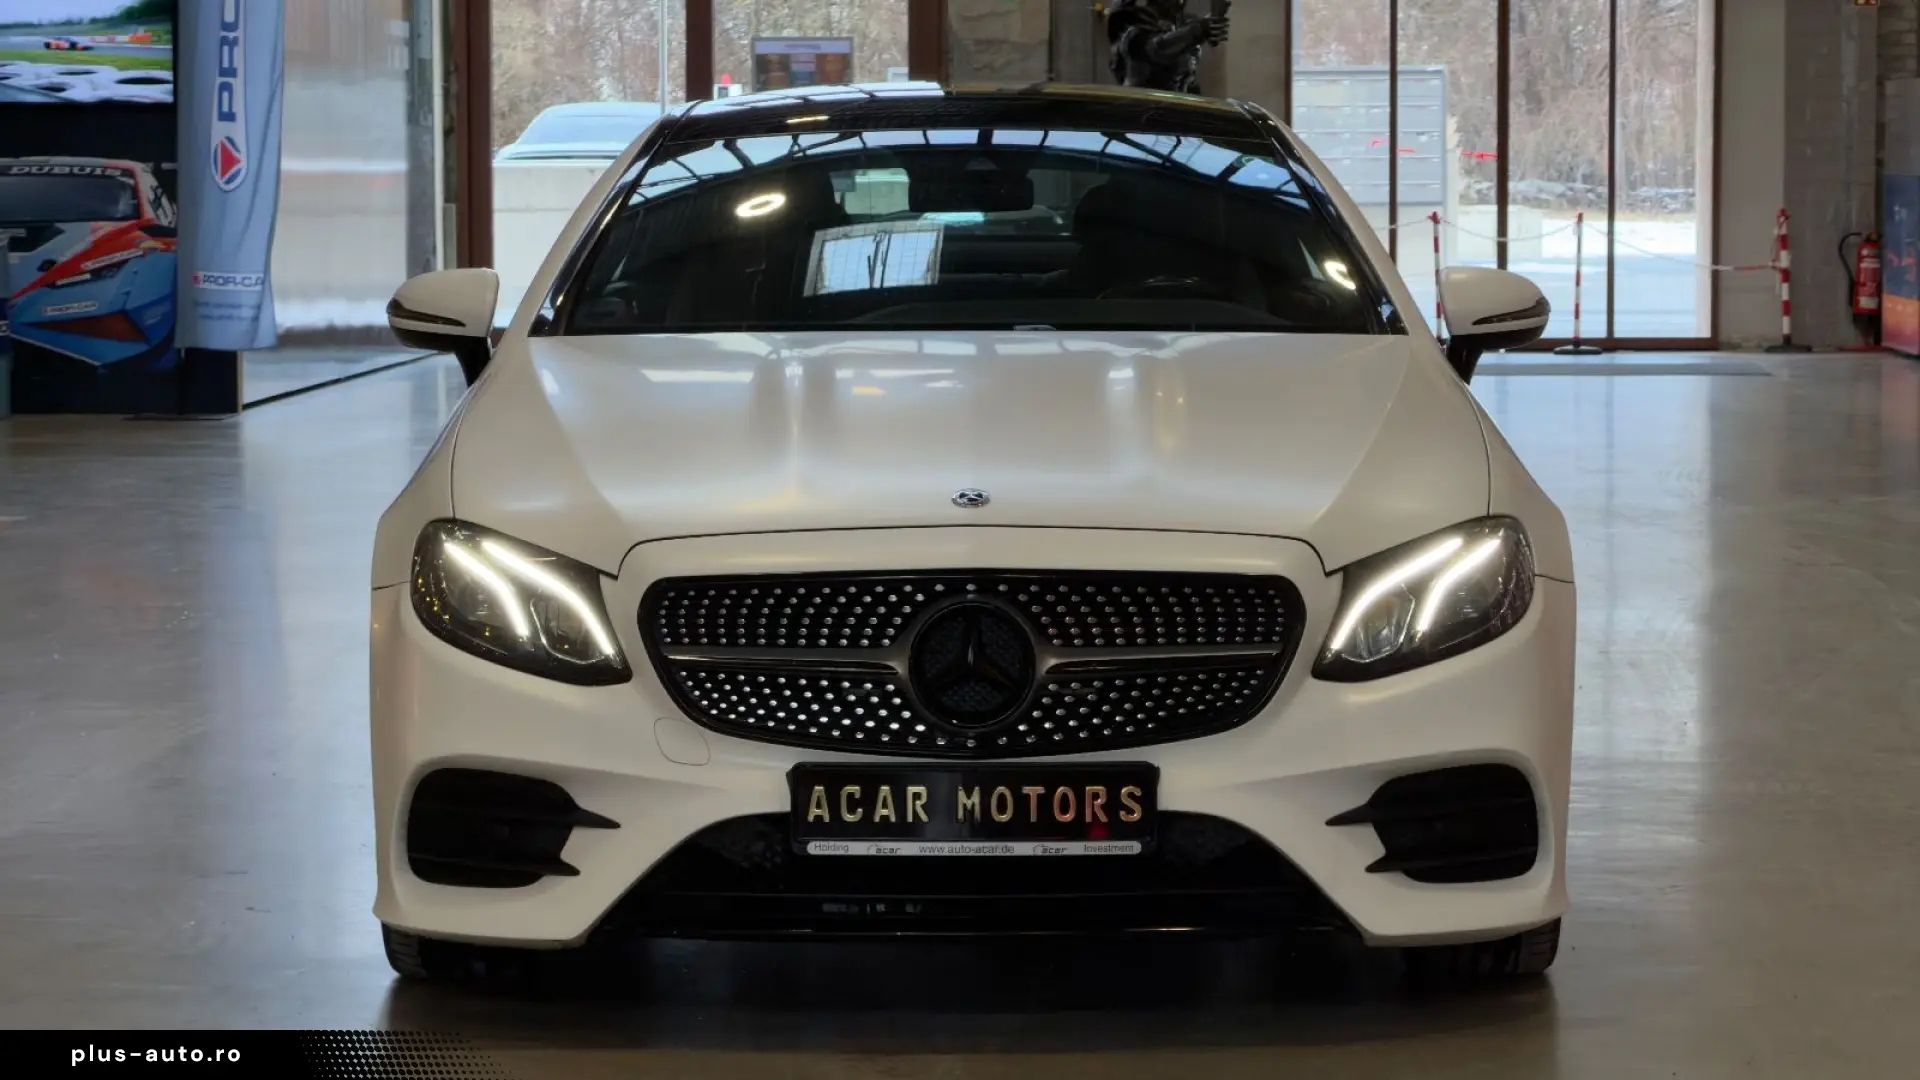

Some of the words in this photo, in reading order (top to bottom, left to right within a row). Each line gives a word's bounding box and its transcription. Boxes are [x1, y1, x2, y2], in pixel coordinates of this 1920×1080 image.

[807, 785, 929, 823] ACAR
[956, 785, 1142, 823] MOTORS
[814, 843, 849, 853] Holding
[919, 844, 1015, 854] www.auto-acar.de
[1084, 844, 1134, 853] Investment
